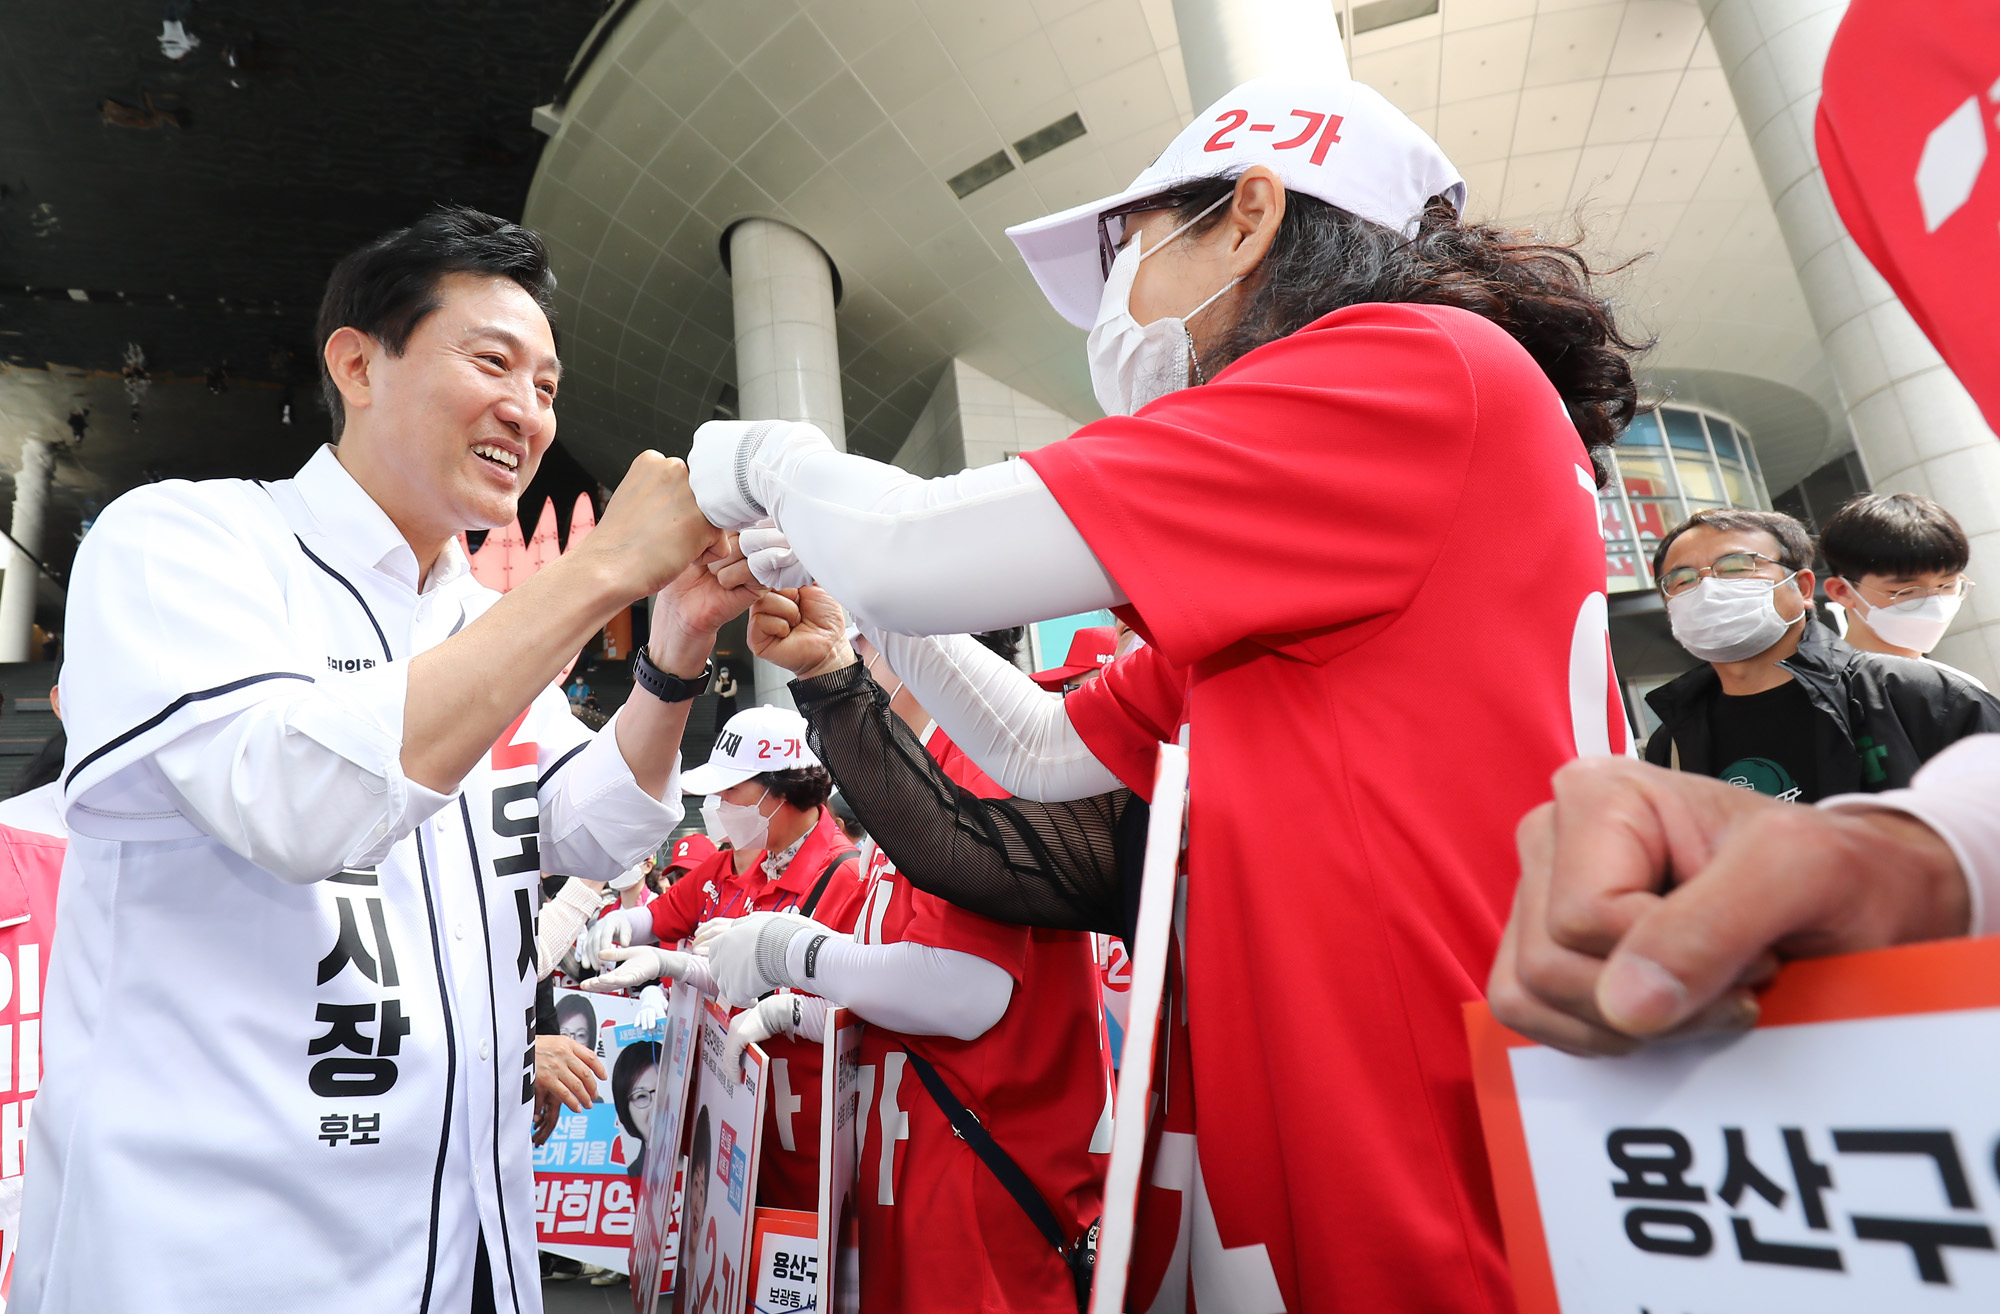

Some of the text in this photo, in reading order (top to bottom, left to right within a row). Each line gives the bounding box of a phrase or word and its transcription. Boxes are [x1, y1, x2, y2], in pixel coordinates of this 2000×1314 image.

[1204, 109, 1343, 166] 2-가
[757, 738, 802, 759] 2-가
[678, 841, 689, 857] 2
[307, 864, 411, 1097] 시장
[1107, 940, 1131, 984] 2
[318, 1112, 381, 1147] 후보
[569, 1141, 607, 1166] 키울
[534, 1179, 636, 1236] 박희영
[1606, 1127, 2000, 1286] 용산구
